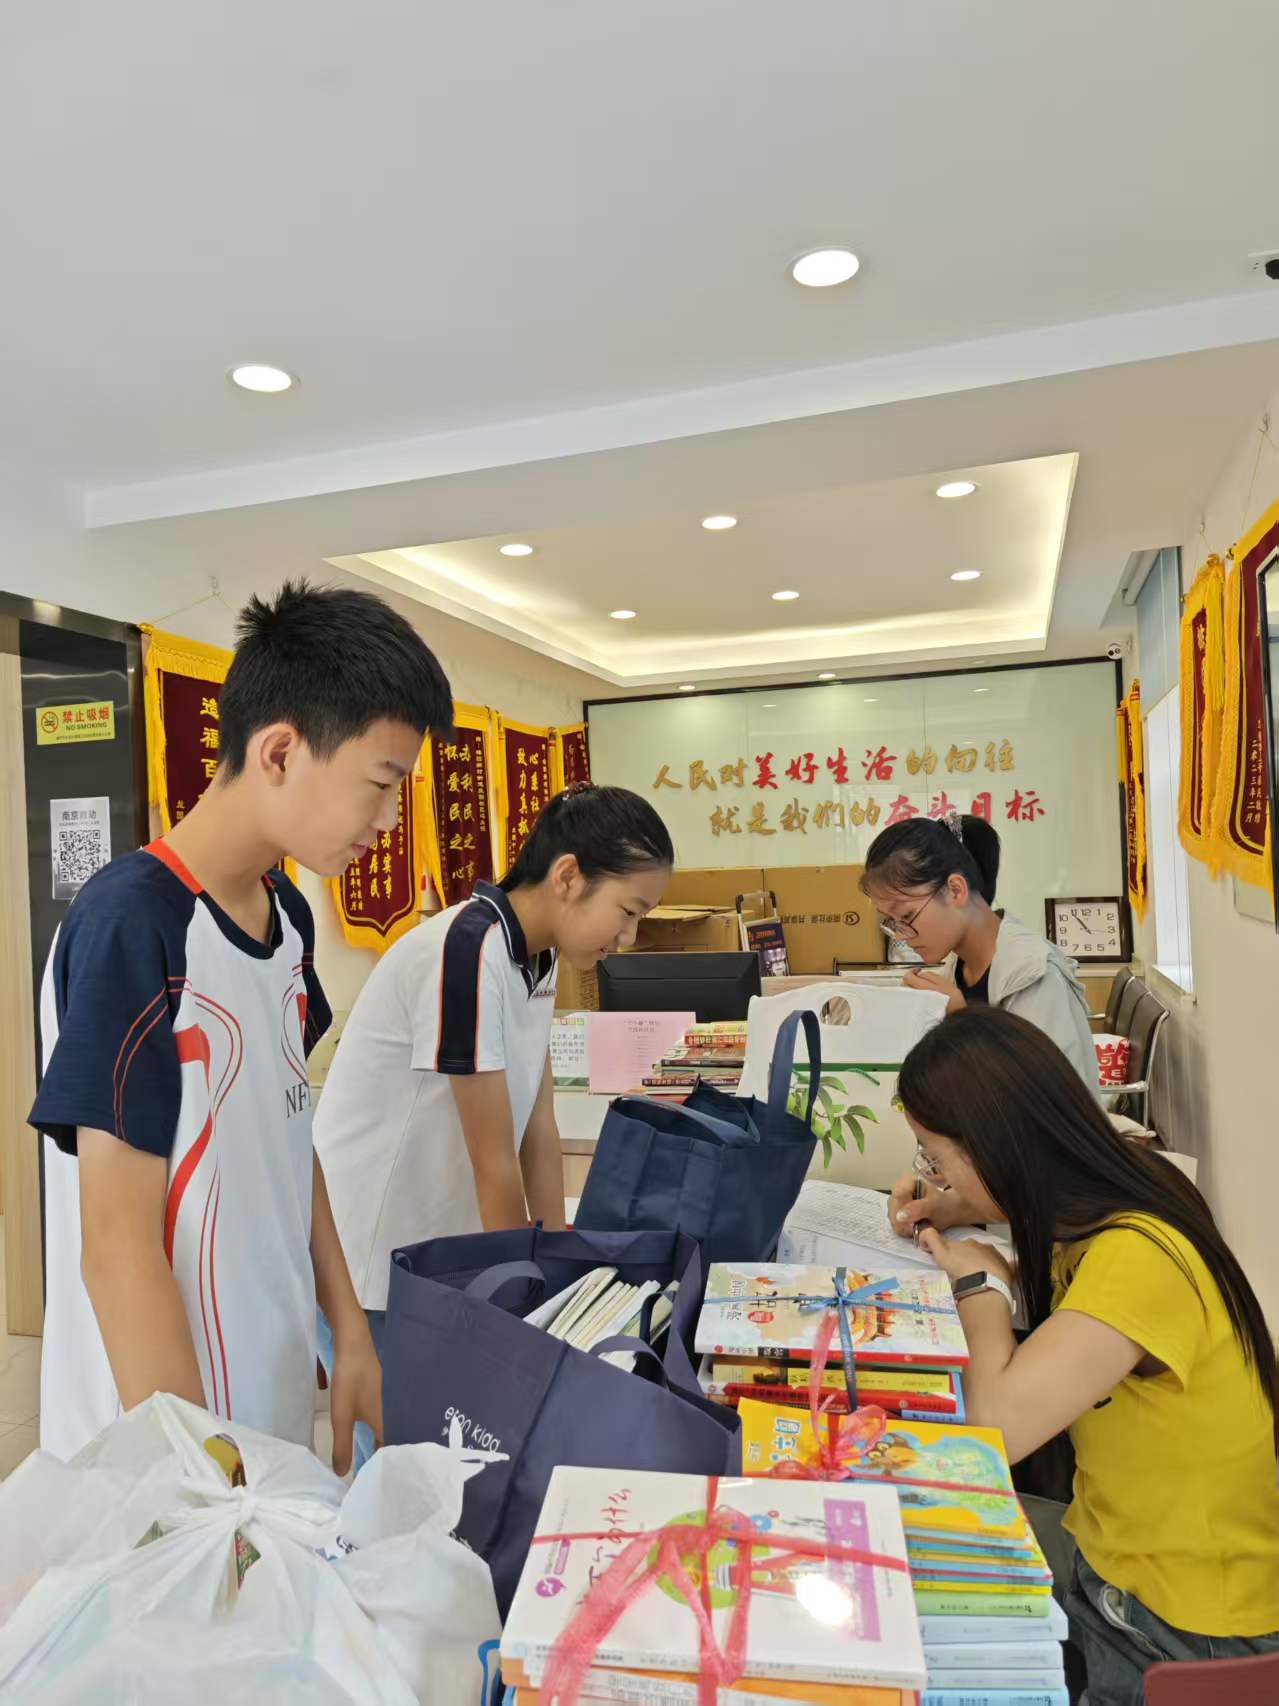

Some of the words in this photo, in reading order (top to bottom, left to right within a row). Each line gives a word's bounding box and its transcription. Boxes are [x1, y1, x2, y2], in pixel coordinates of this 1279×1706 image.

[62, 706, 110, 724] 禁止吸烟
[76, 722, 108, 730] SMOKING
[652, 738, 1016, 792] 人民对美好生活的向往
